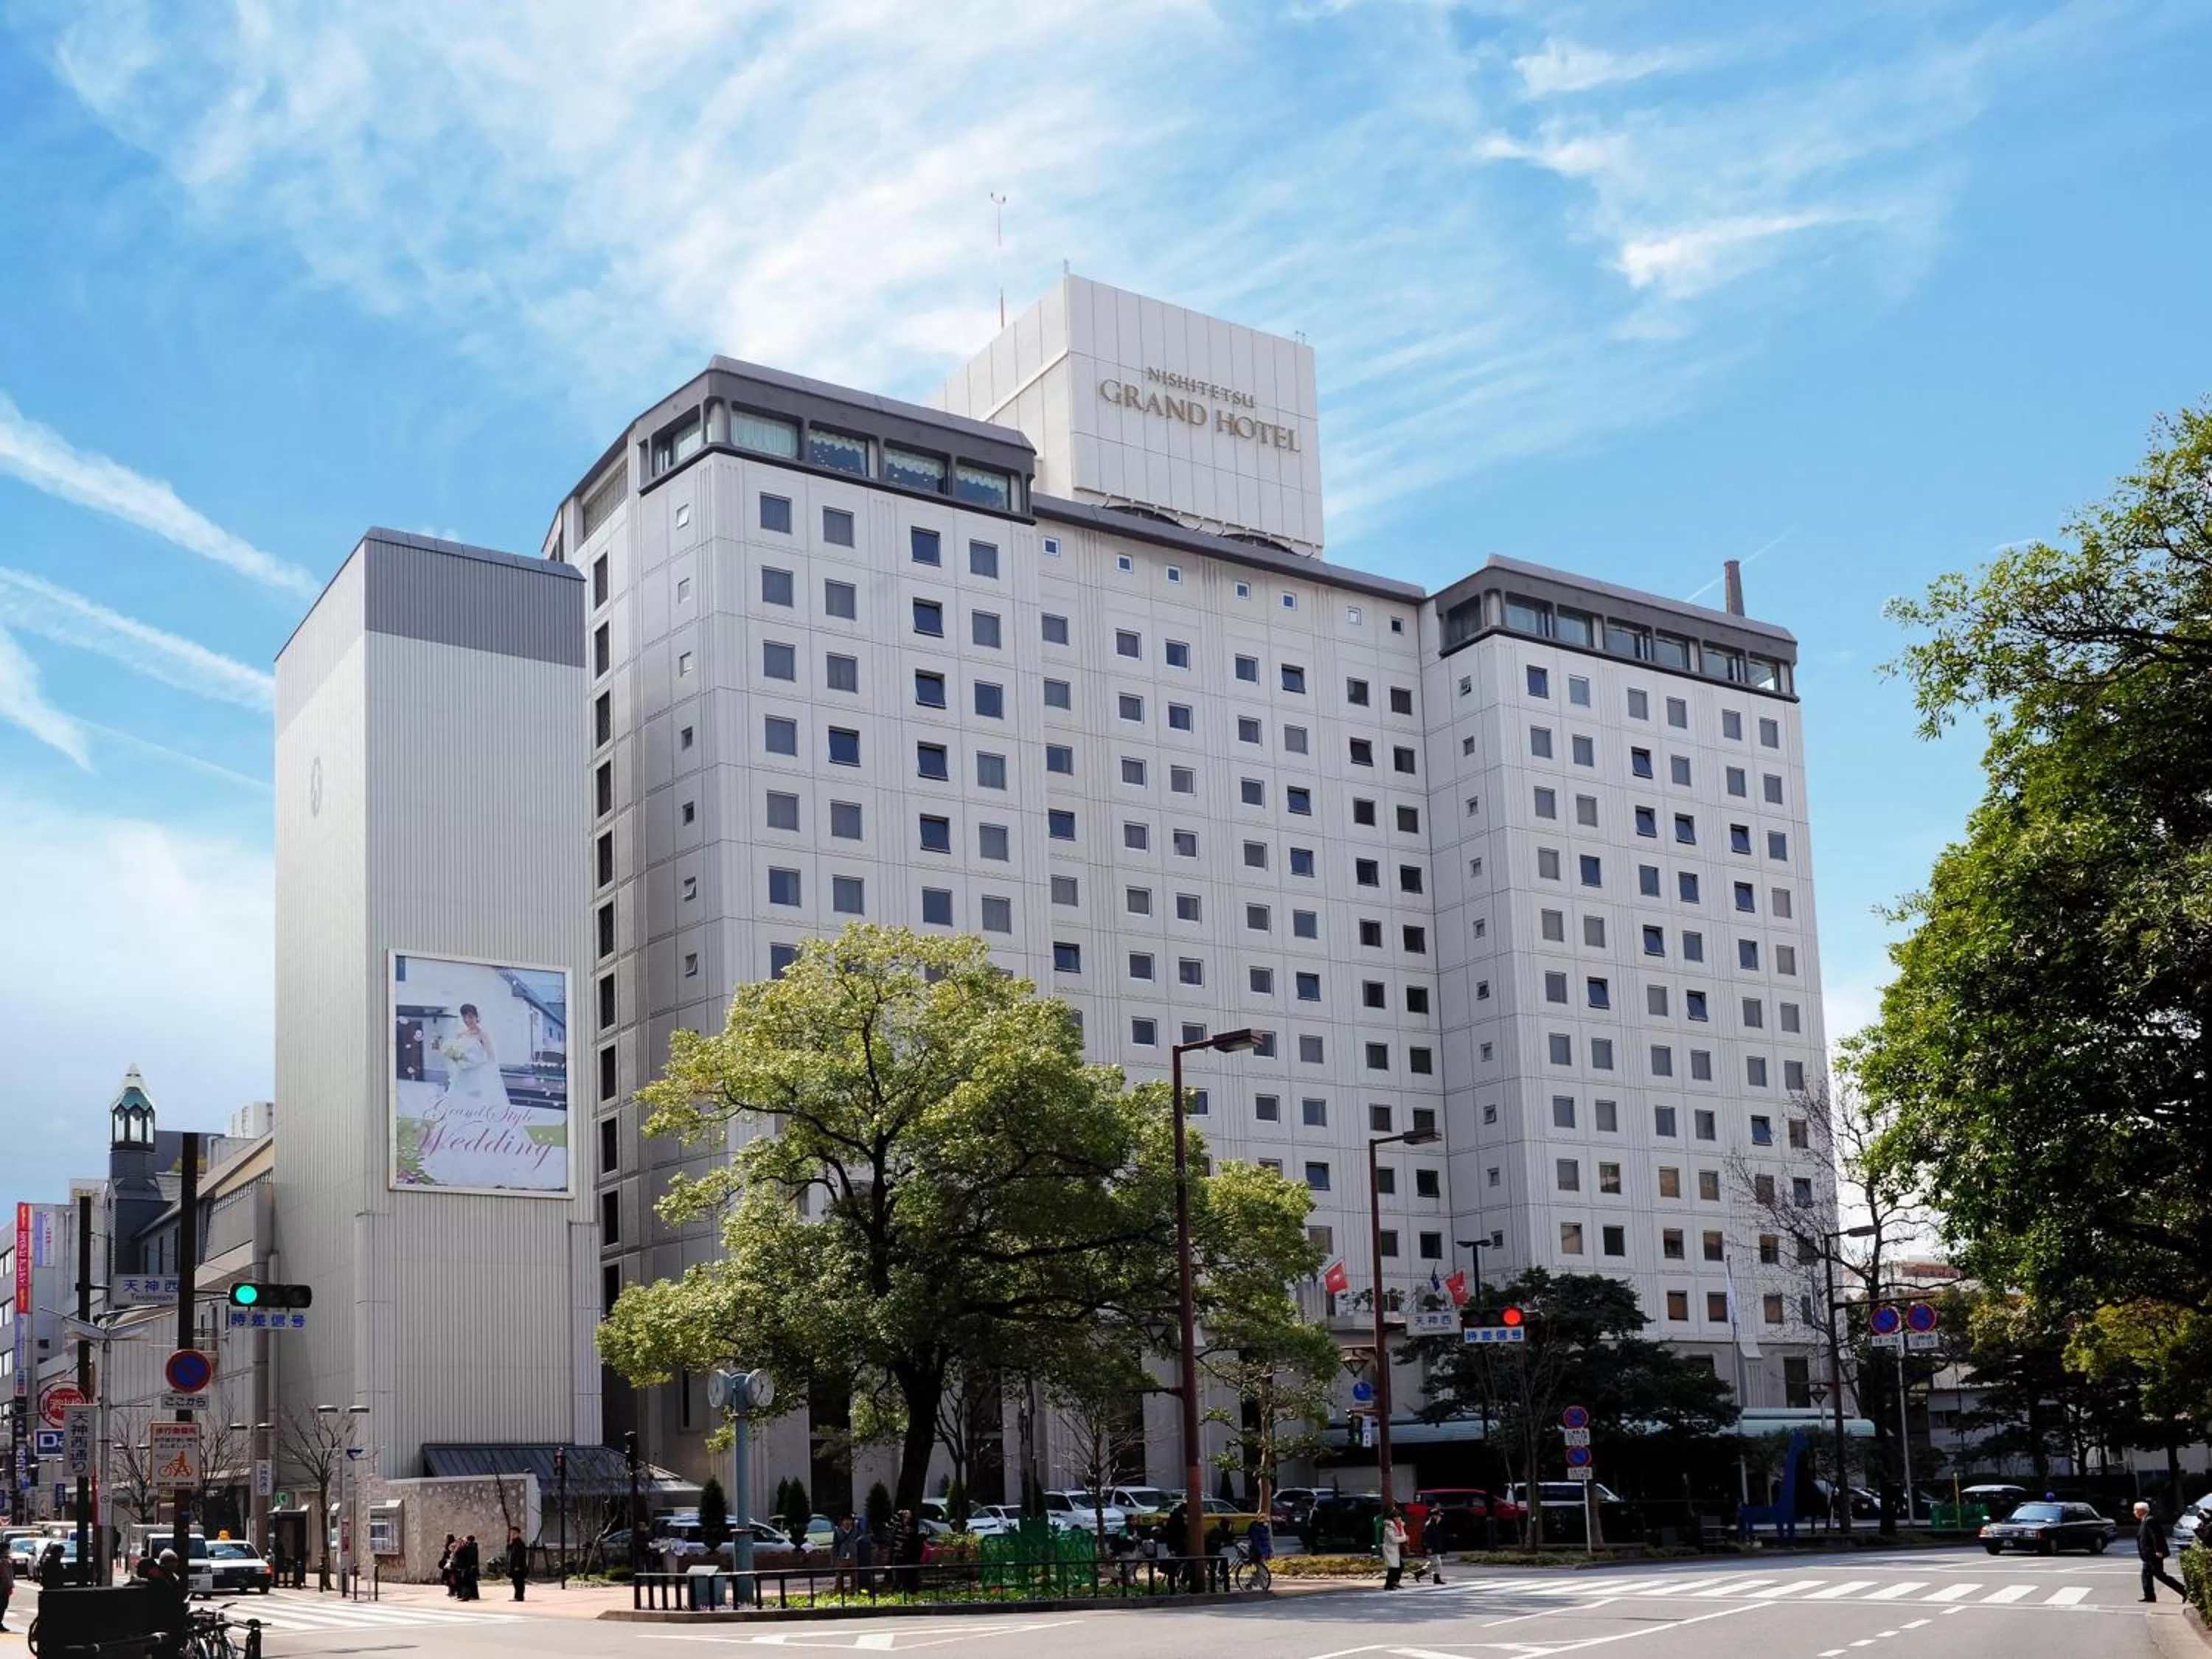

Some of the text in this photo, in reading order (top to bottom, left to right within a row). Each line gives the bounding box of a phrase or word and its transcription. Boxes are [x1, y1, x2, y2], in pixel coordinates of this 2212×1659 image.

[1147, 366, 1255, 408] NISHITETSU
[1099, 378, 1301, 453] GRAND HOTEL
[418, 1120, 553, 1170] Wedding
[165, 1397, 206, 1407] ここから
[72, 1411, 88, 1473] 天神西通り
